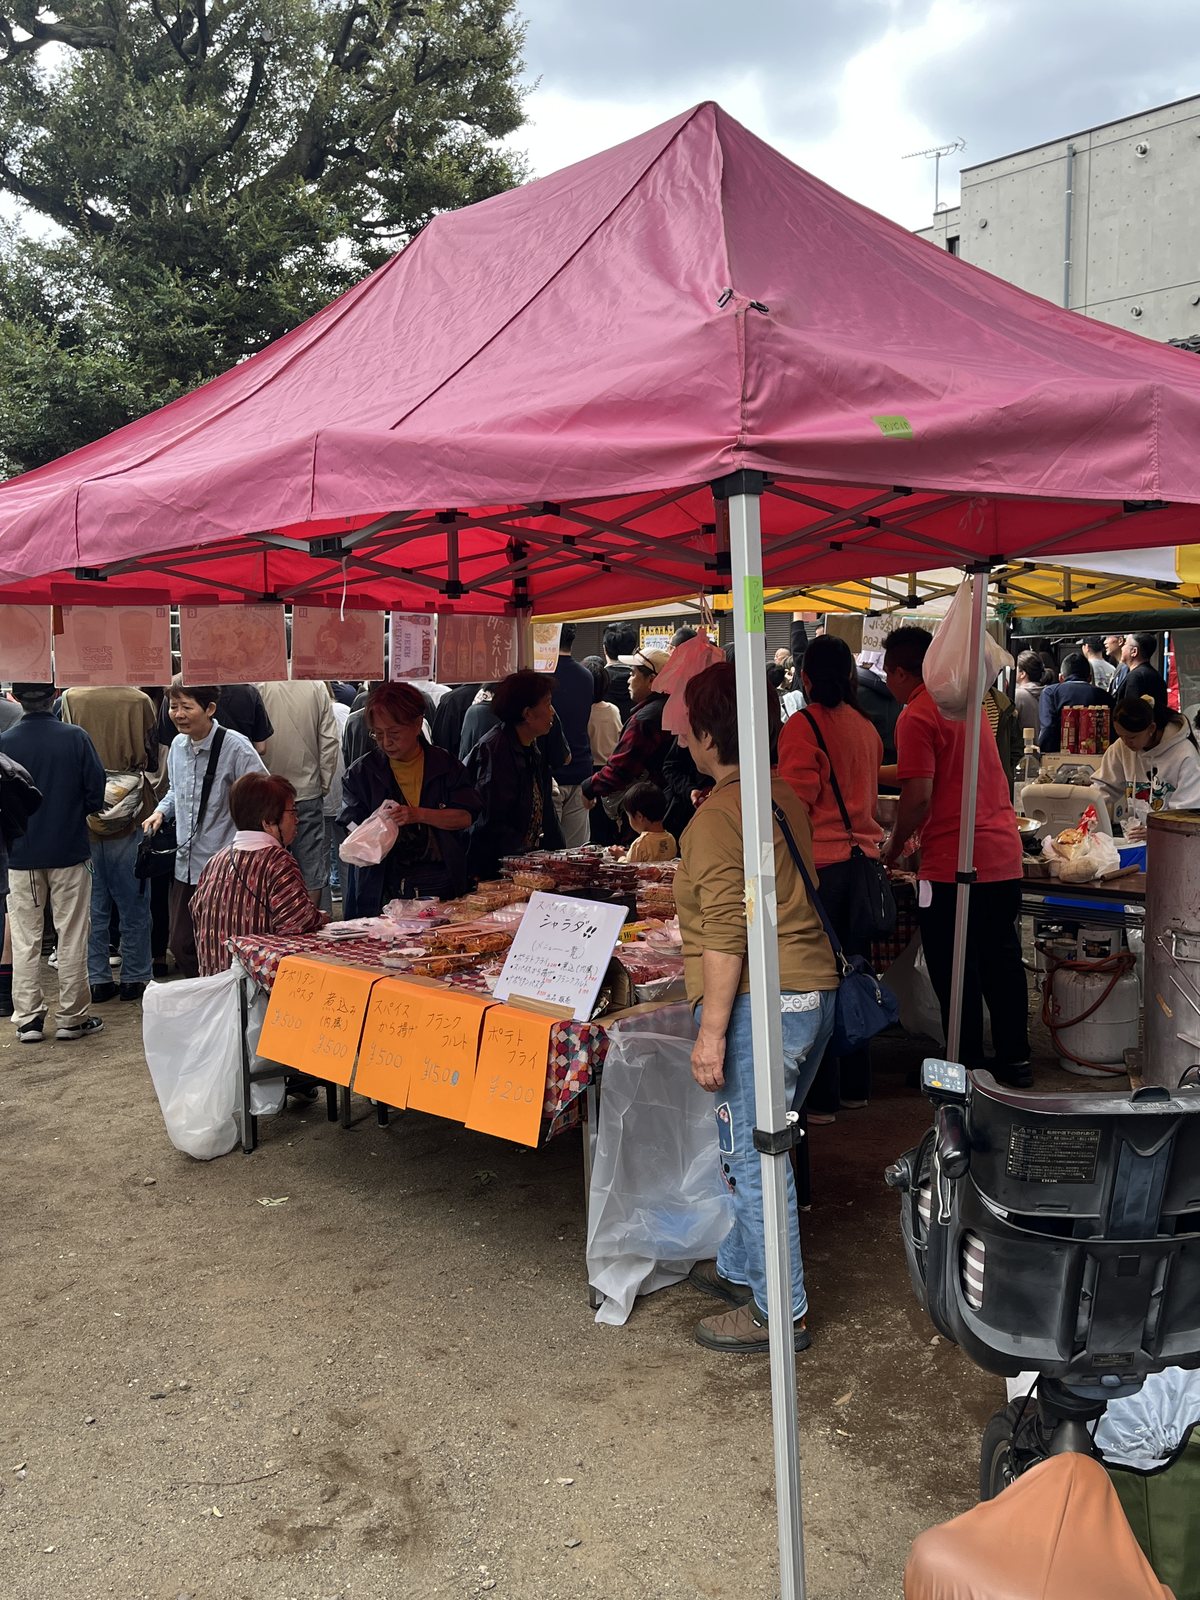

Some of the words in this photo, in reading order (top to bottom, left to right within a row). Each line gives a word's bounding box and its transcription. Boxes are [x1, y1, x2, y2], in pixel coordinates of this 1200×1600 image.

[374, 1000, 411, 1019] スパイス
[378, 1021, 418, 1039] から揚げ
[425, 1012, 462, 1031] フランク
[441, 1032, 468, 1050] フルト
[487, 1025, 524, 1047] ポテト
[507, 1050, 539, 1071] フライ
